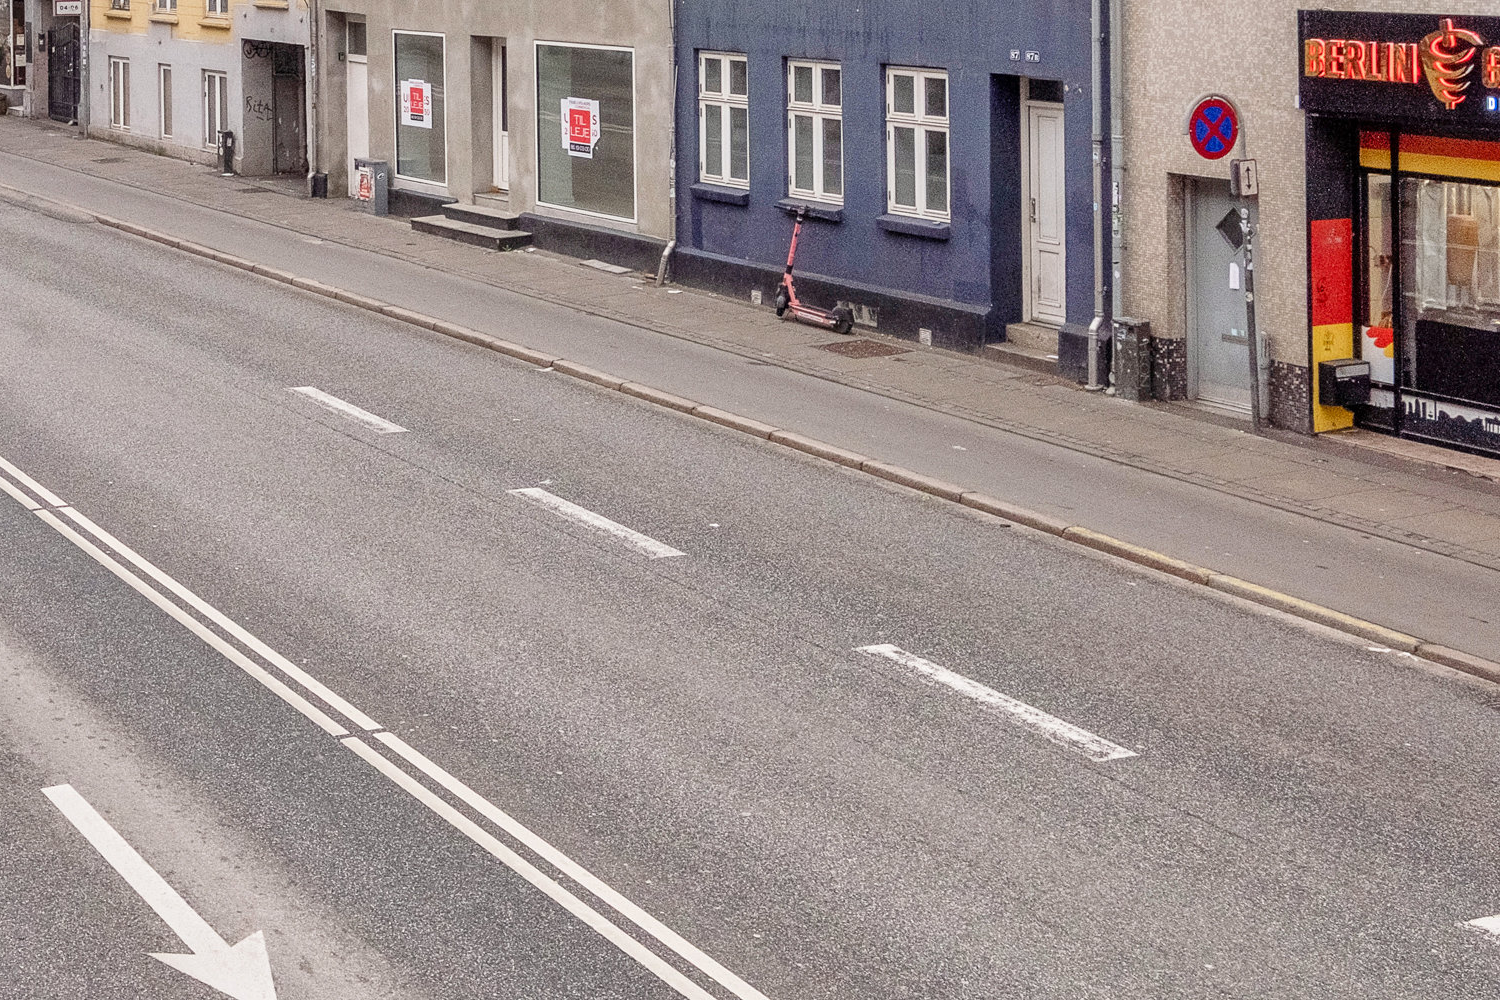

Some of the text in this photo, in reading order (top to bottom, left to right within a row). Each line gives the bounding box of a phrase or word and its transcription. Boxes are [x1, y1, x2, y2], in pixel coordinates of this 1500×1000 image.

[1304, 38, 1419, 84] BERLIN
[573, 114, 587, 126] TIL
[570, 126, 590, 138] LEJE
